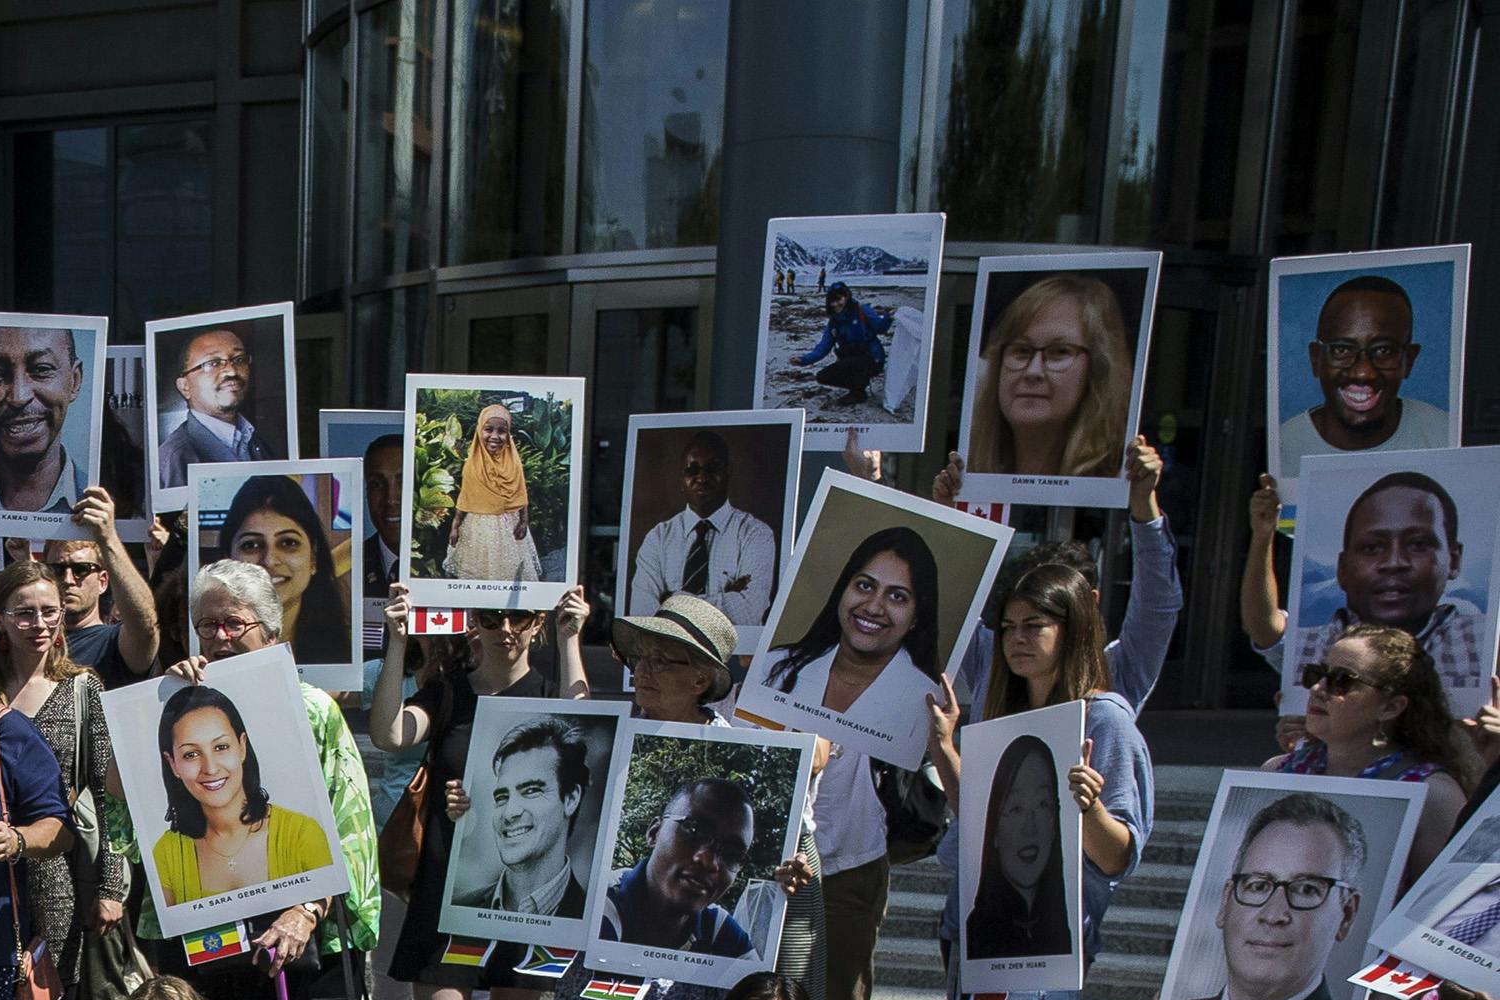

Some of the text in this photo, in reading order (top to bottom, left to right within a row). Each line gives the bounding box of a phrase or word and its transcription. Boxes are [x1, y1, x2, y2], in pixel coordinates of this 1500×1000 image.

[1012, 477, 1070, 486] DAWN TANNER
[1, 514, 28, 522] KAMAU
[773, 695, 894, 742] DR. MANISHA NUKAVARAPU
[193, 875, 312, 911] FA SARA GEBRE MICHAEL
[494, 914, 525, 923] THABISO
[526, 917, 552, 926] EDKINS
[643, 950, 714, 967] GEORGE KABAU
[1421, 932, 1493, 968] PIUS ADEBOLA
